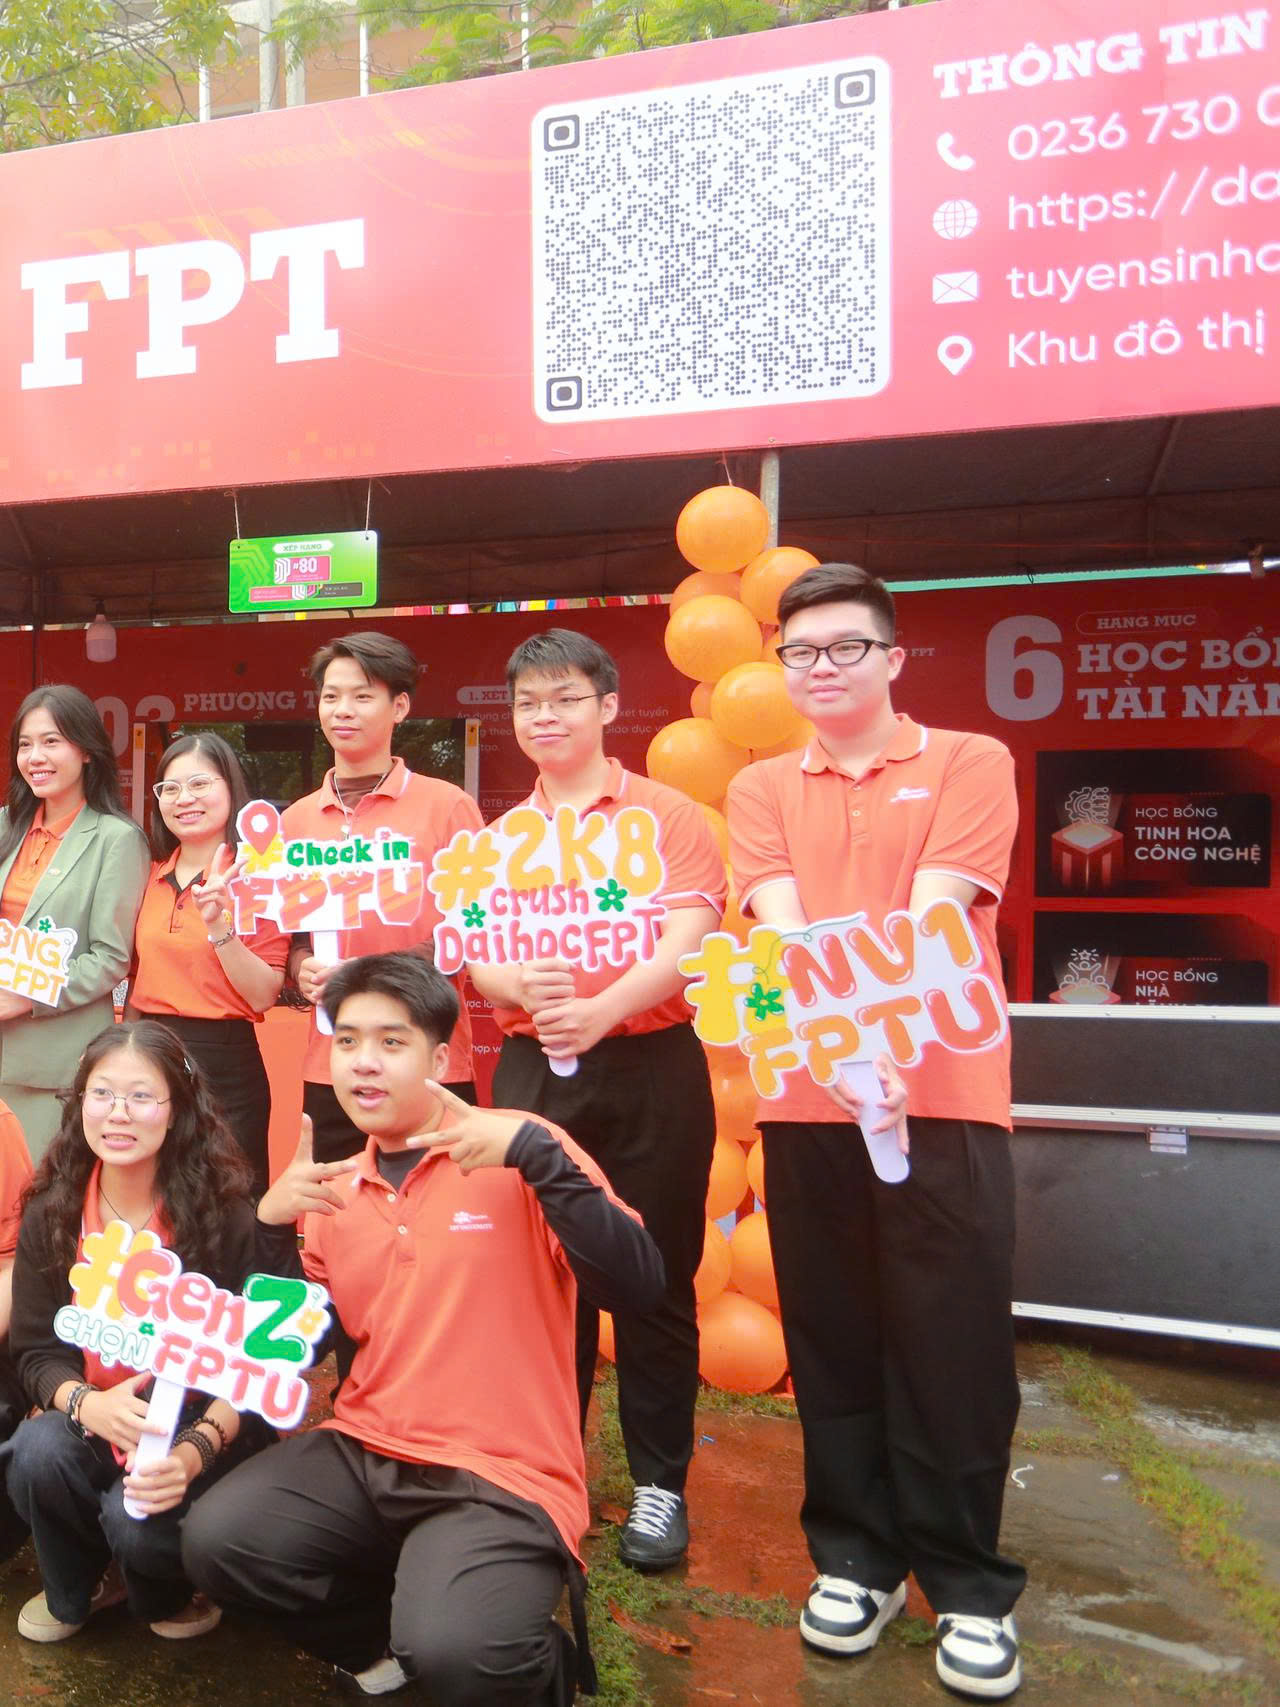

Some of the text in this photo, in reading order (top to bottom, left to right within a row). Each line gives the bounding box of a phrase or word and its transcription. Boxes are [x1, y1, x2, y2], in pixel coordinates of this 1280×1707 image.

[933, 10, 1269, 98] THÔNG TIN
[1008, 112, 1128, 160] 0236
[1141, 95, 1240, 144] 730
[20, 218, 365, 391] FPT
[1008, 308, 1265, 368] Khu đô thị
[986, 615, 1063, 721] 6
[1077, 626, 1280, 678] HỌC BỔ
[1076, 679, 1166, 720] TÀI
[1135, 807, 1168, 820] HỌC
[1135, 826, 1232, 840] TINH HOA
[287, 838, 410, 867] Check in
[432, 806, 665, 911] #2K8
[1135, 844, 1261, 865] CÔNG NGHỆ
[233, 865, 424, 934] FPTU
[490, 879, 589, 916] crush
[678, 902, 976, 1044] #NV1
[1136, 970, 1169, 983] HỌC
[1136, 983, 1170, 997] NHÀ
[740, 977, 1002, 1098] FPTU
[54, 1308, 303, 1421] CHỌN FPTU
